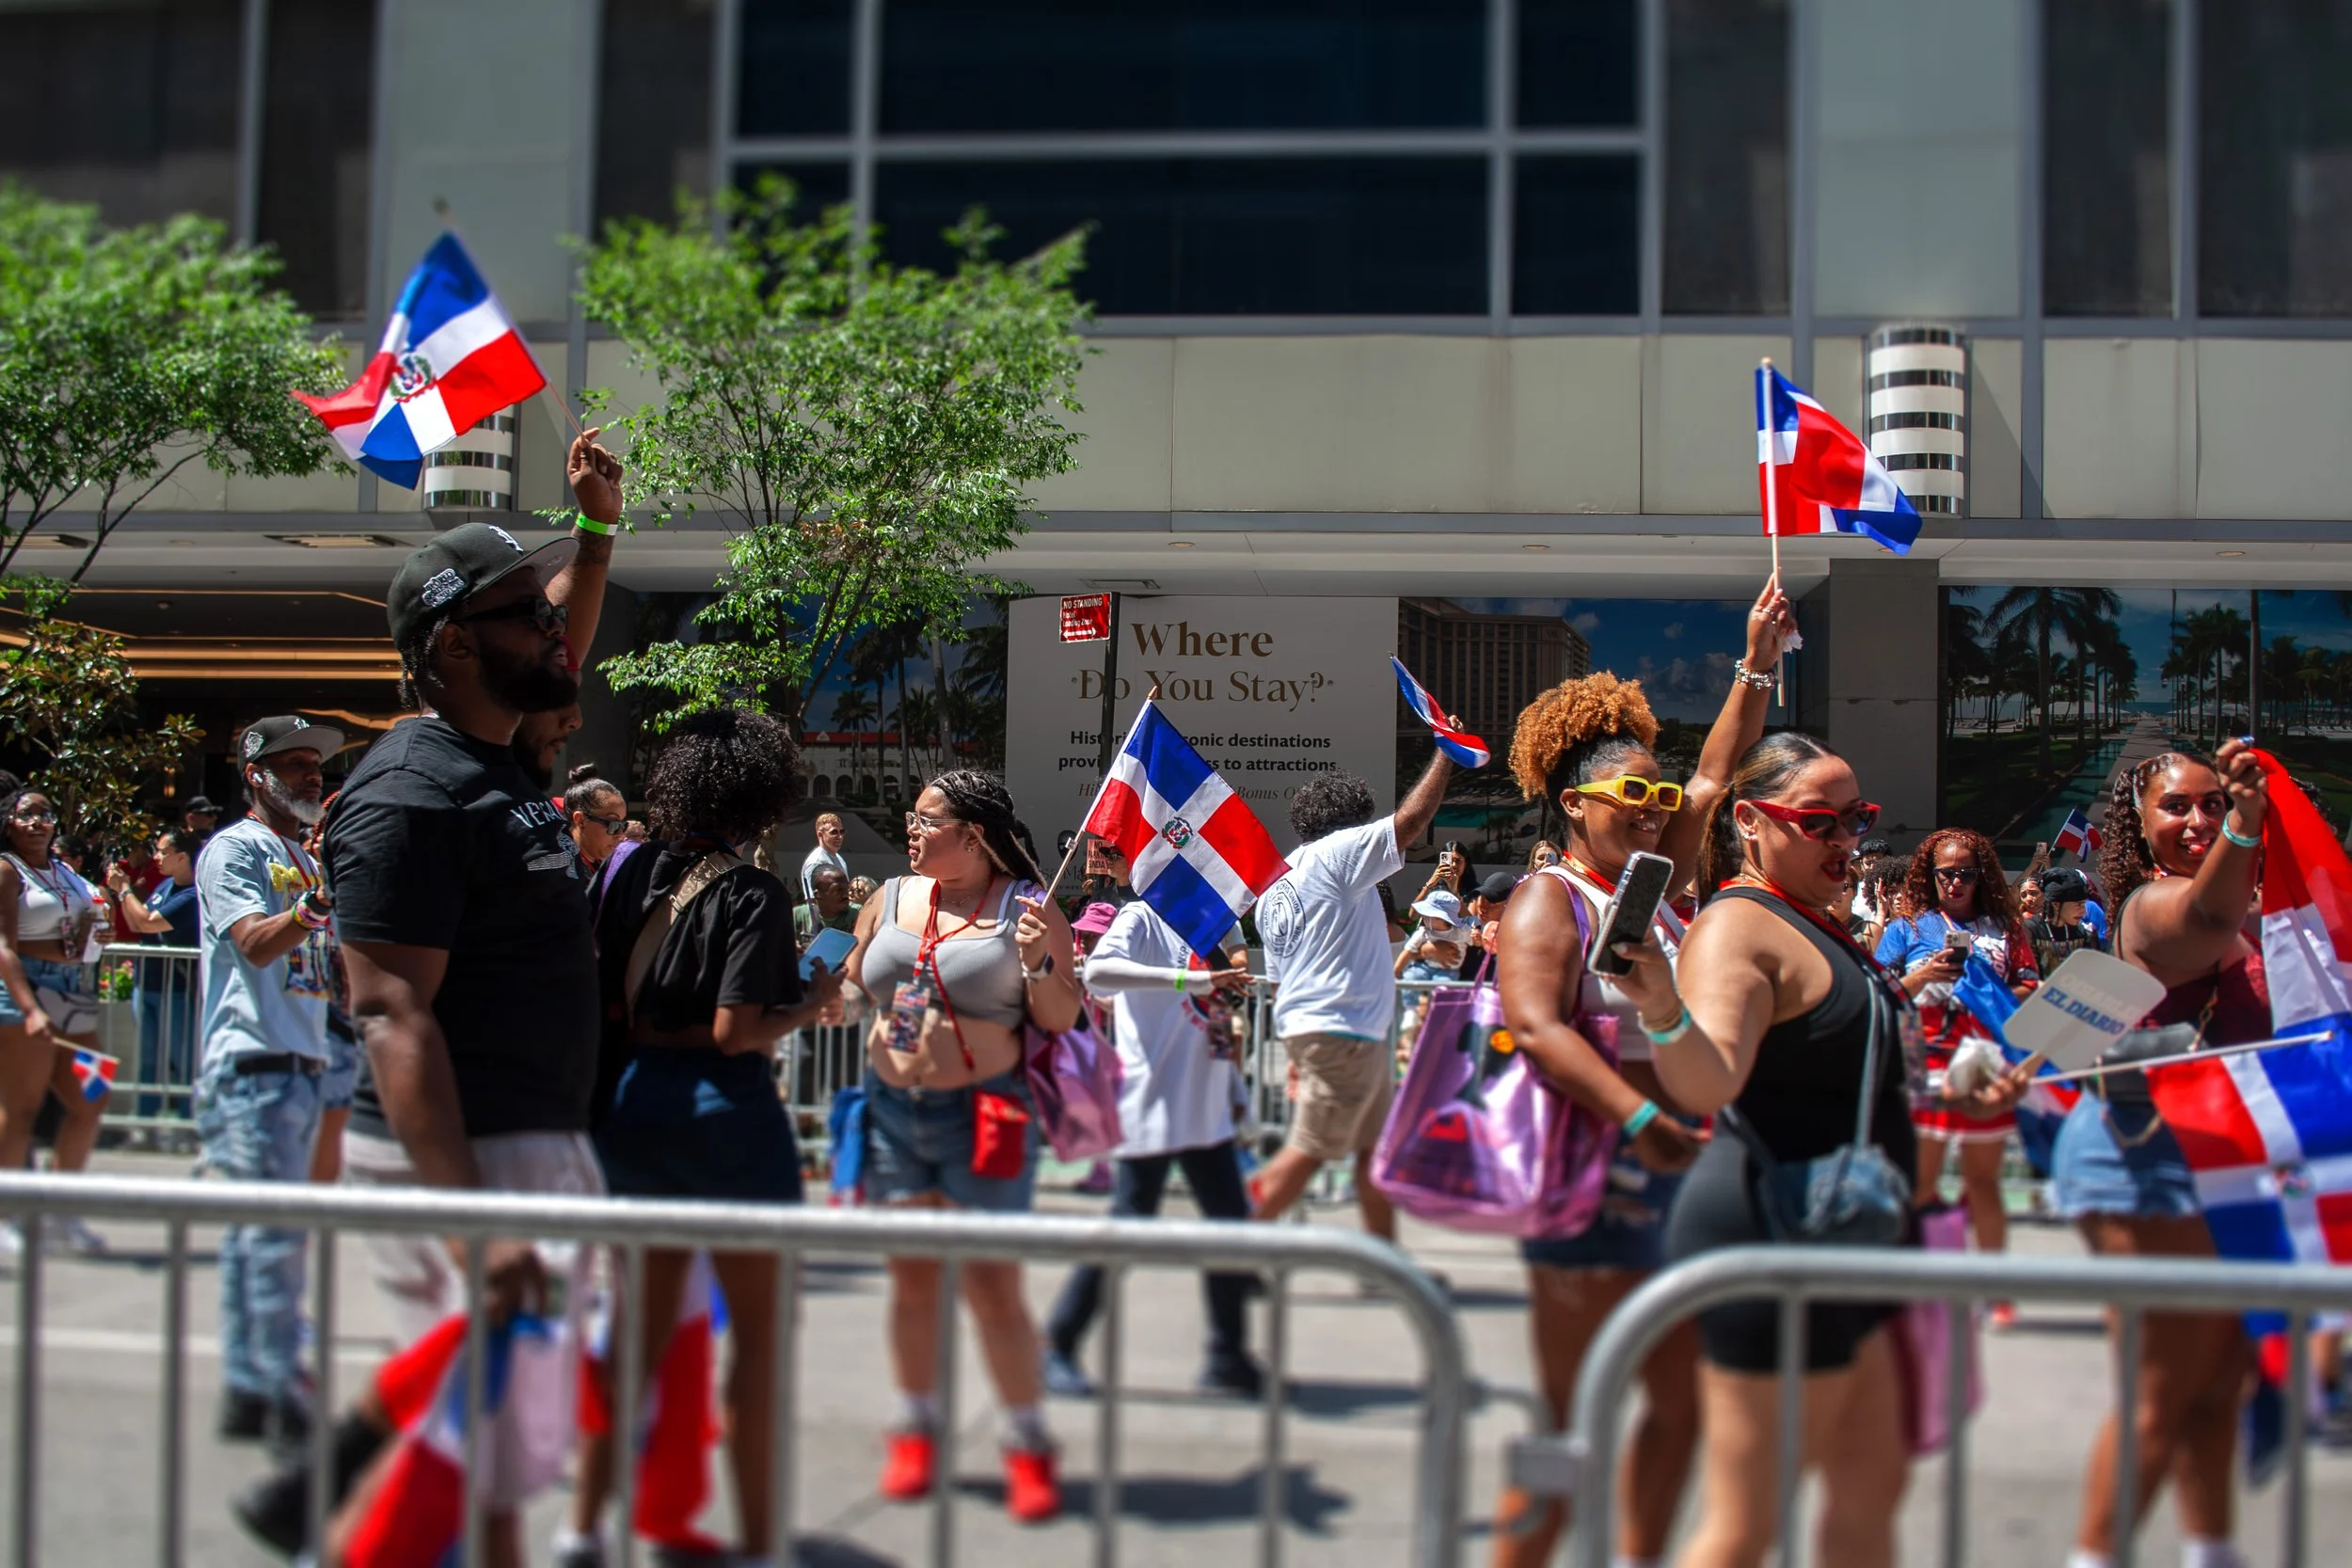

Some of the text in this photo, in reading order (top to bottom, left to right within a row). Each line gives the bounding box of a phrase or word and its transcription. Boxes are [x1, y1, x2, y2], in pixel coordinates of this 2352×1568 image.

[1063, 597, 1103, 610] NO STANDING
[1131, 621, 1273, 657] Where
[1079, 669, 1325, 713] Do You Stay?
[1228, 733, 1331, 749] destinations
[1223, 758, 1242, 771] to
[1236, 785, 1279, 800] Bonus
[1289, 891, 1301, 914] UNION
[2042, 987, 2069, 1009] EL
[2065, 999, 2125, 1035] DIARIO
